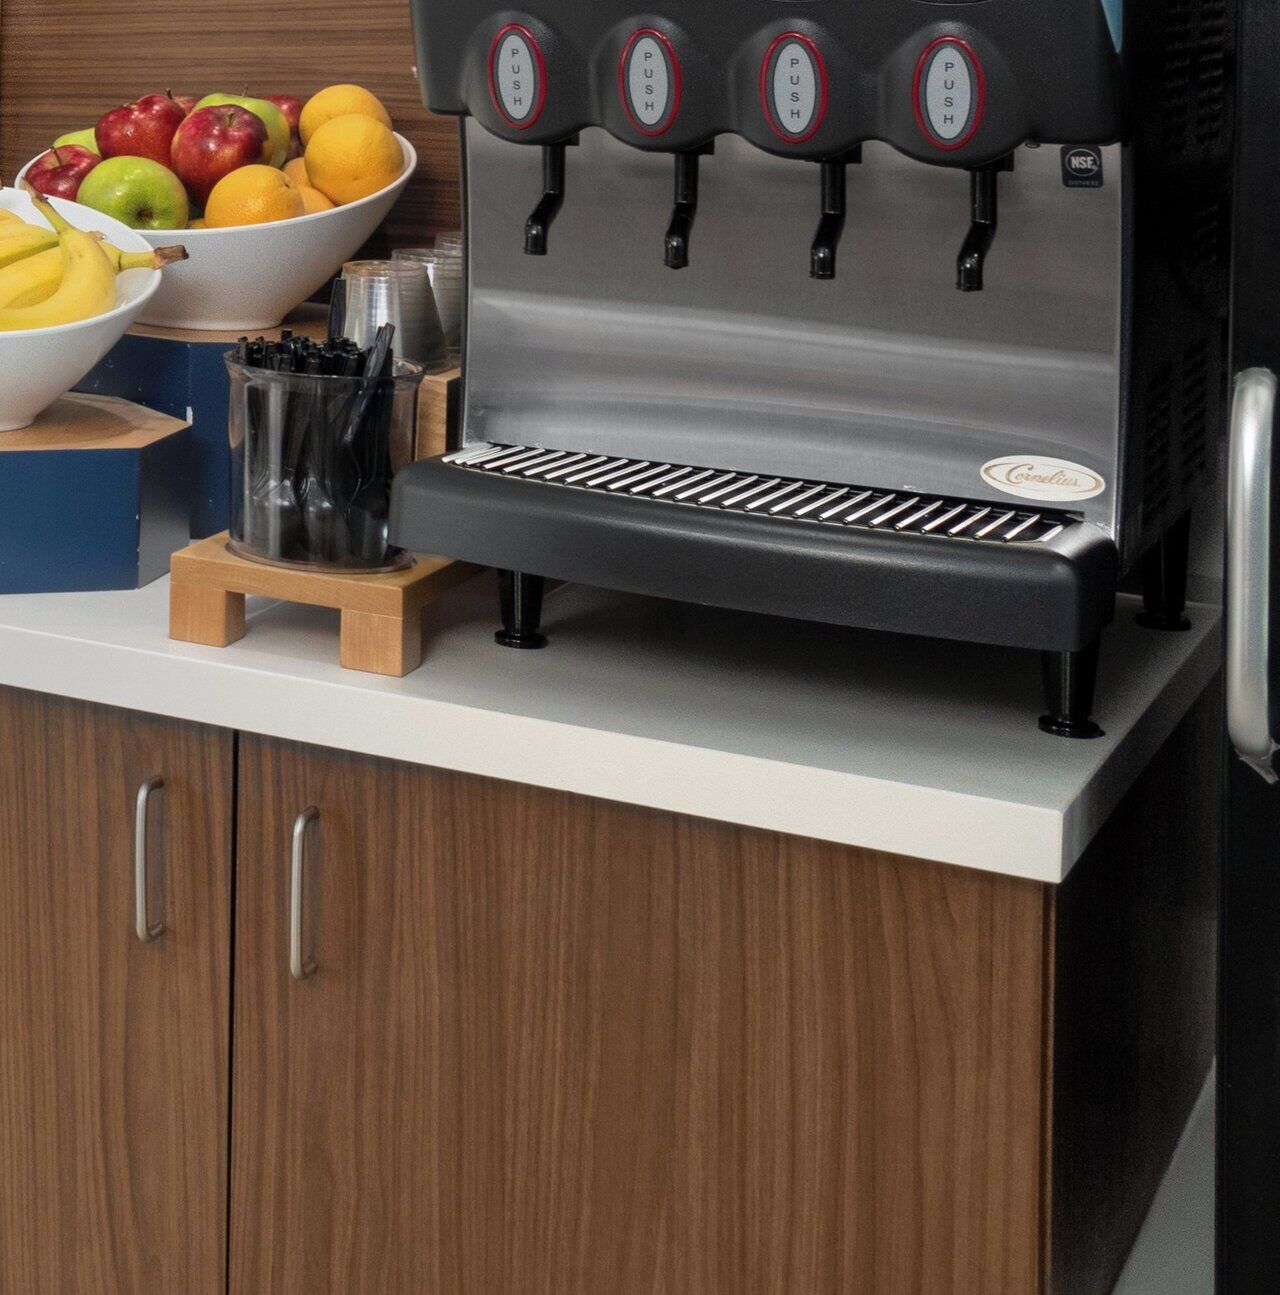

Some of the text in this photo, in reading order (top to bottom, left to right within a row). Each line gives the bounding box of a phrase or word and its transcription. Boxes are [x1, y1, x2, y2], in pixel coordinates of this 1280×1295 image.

[510, 48, 523, 106] PUSH
[643, 51, 655, 112] PUSH
[789, 58, 801, 120] PUSH
[943, 62, 955, 125] PUSH
[1070, 155, 1095, 169] NSF
[1005, 463, 1078, 487] Cornelius
